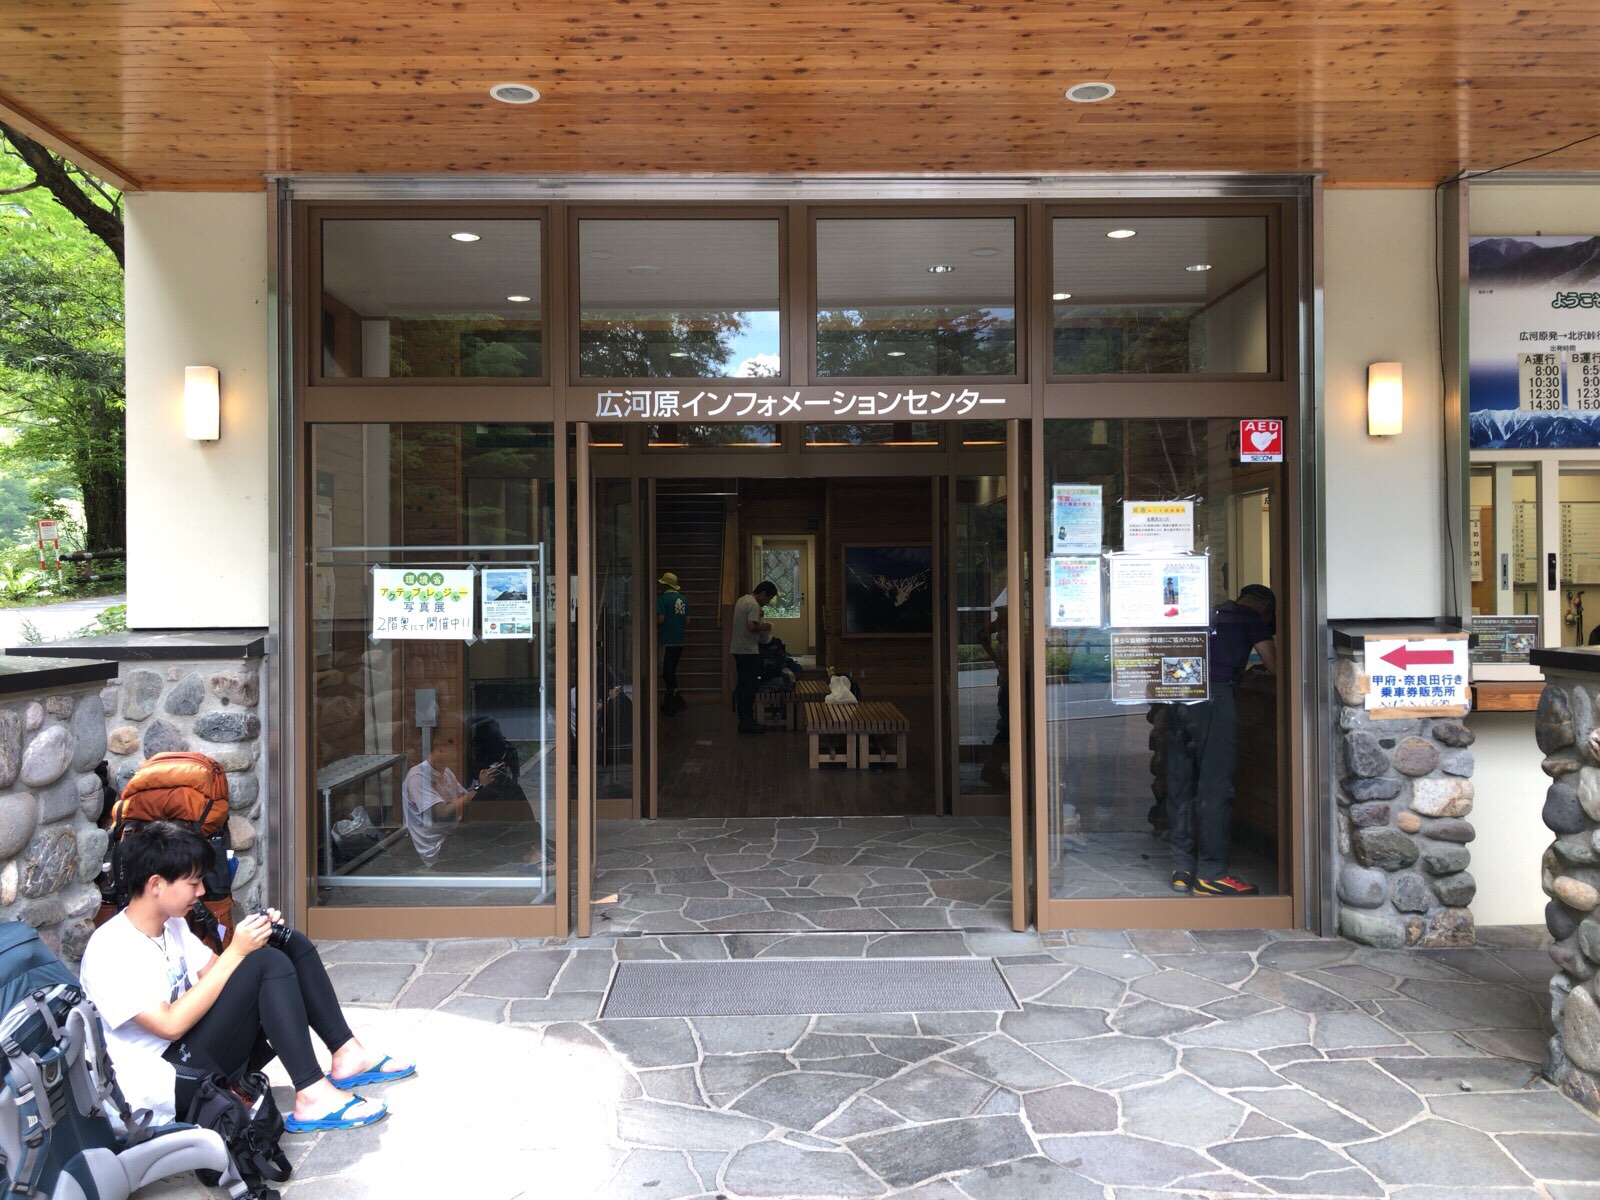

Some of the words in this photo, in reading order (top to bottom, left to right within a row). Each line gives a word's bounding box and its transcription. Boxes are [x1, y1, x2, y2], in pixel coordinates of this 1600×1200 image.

[1520, 331, 1558, 341] 広河原発
[1524, 354, 1556, 365] A運行
[1536, 366, 1559, 376] 8:00
[1582, 364, 1600, 376] 6:5
[1529, 377, 1559, 388] 10:30
[1582, 376, 1600, 387] 9:0
[1530, 388, 1560, 399] 12:30
[1577, 388, 1600, 398] 12:3
[596, 390, 1006, 418] 広河原インフォメーションセンター
[1530, 400, 1560, 410] 14:30
[1578, 399, 1600, 410] 15:0
[1244, 422, 1279, 431] AED
[404, 574, 443, 586] 環境省
[404, 602, 446, 613] 写真展
[1372, 675, 1463, 686] 甲府・奈良田行き
[1381, 686, 1455, 697] 乗車券販売所
